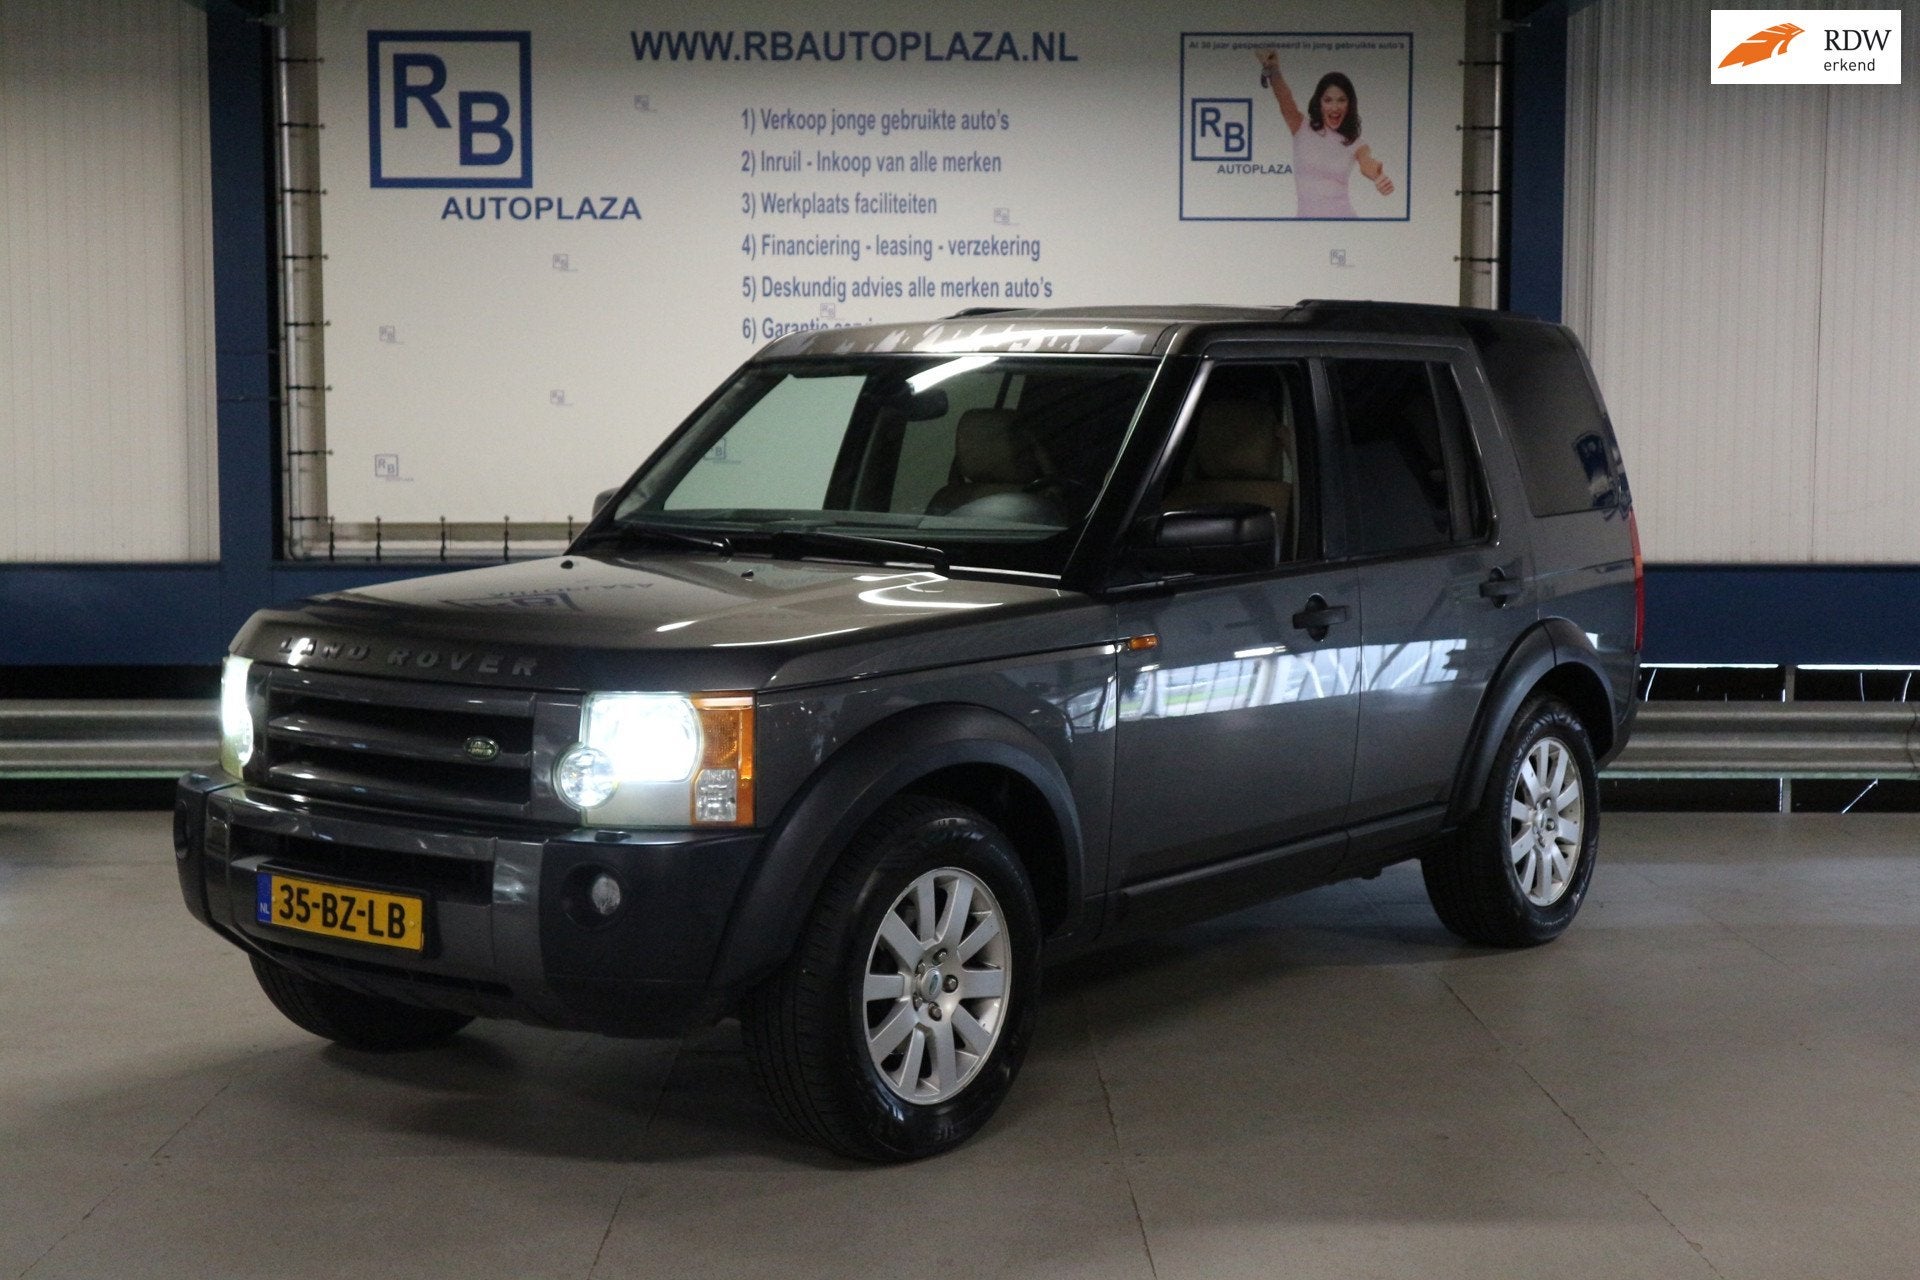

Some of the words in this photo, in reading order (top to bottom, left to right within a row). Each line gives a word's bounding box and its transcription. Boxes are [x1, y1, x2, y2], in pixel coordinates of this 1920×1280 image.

[631, 31, 1078, 62] WWW.RBAUTOPLAZA.NL
[393, 53, 514, 166] RB
[742, 108, 755, 134] 1)
[760, 108, 826, 135] Verkoop
[831, 109, 876, 136] jonge
[881, 109, 956, 135] gebruikte
[961, 109, 1009, 130] auto's
[1201, 107, 1245, 152] RB
[741, 150, 756, 176] 2)
[761, 151, 801, 172] Inruil
[817, 151, 871, 176] Inkoop
[877, 156, 904, 172] van
[910, 151, 937, 172] alle
[943, 151, 1001, 172] merken
[1217, 163, 1292, 174] AUTOPLAZA
[441, 197, 641, 220] AUTOPLAZA
[742, 192, 756, 218] 3)
[761, 193, 849, 218] Werkplaats
[855, 192, 936, 214] faciliteiten
[742, 234, 756, 260] 4)
[762, 234, 860, 262] Financiering
[876, 235, 932, 262] leasing
[948, 235, 1040, 262] verzekering
[743, 276, 756, 302] 5)
[762, 276, 846, 303] Deskundig
[852, 277, 903, 297] advies
[909, 277, 935, 297] alle
[941, 277, 999, 297] merken
[1005, 277, 1052, 298] auto's
[743, 317, 756, 343] 6)
[386, 648, 538, 677] ROVER
[259, 902, 270, 914] NL
[279, 883, 406, 939] 35-BZ-LB
